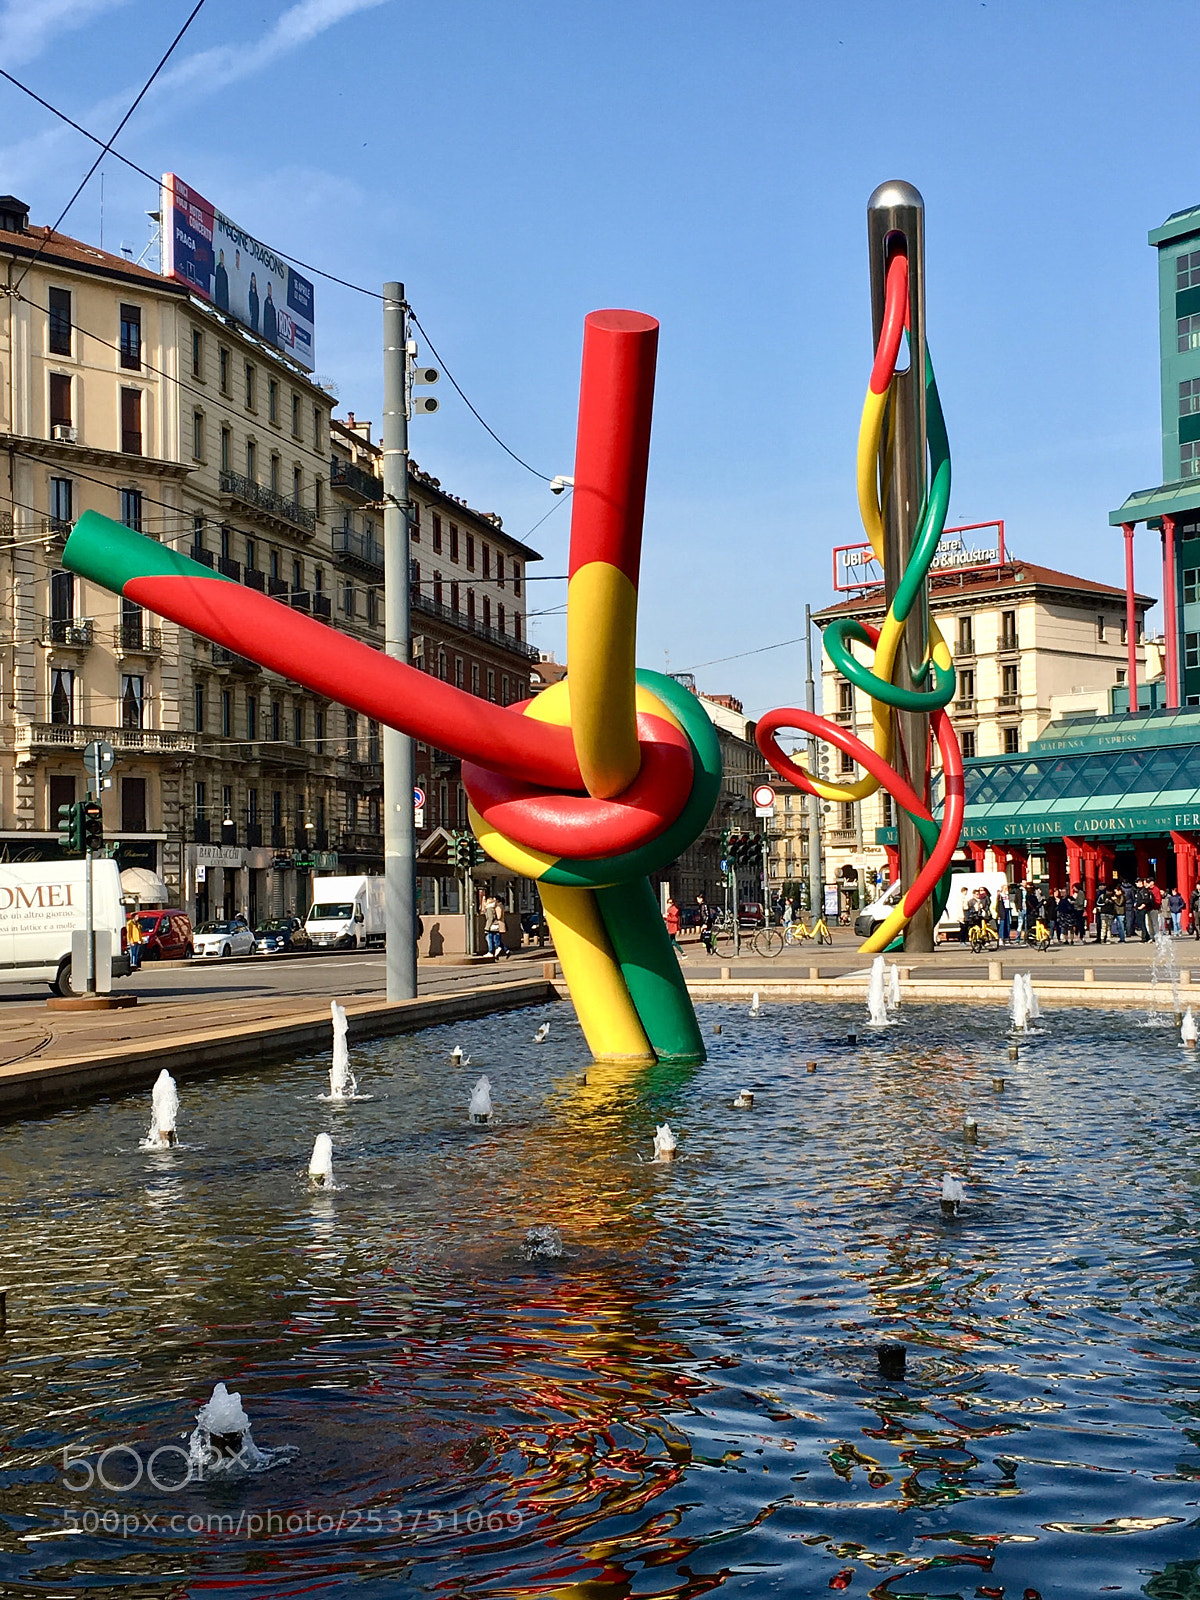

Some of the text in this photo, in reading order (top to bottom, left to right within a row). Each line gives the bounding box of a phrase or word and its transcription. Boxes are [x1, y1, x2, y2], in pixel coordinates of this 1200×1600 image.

[176, 227, 196, 252] PRAGA
[842, 553, 862, 567] UBI
[1039, 735, 1137, 751] MALPENSA EXPRESS
[962, 825, 988, 837] RESS
[1004, 821, 1062, 836] STAZIONE
[1074, 818, 1135, 832] CADORNA
